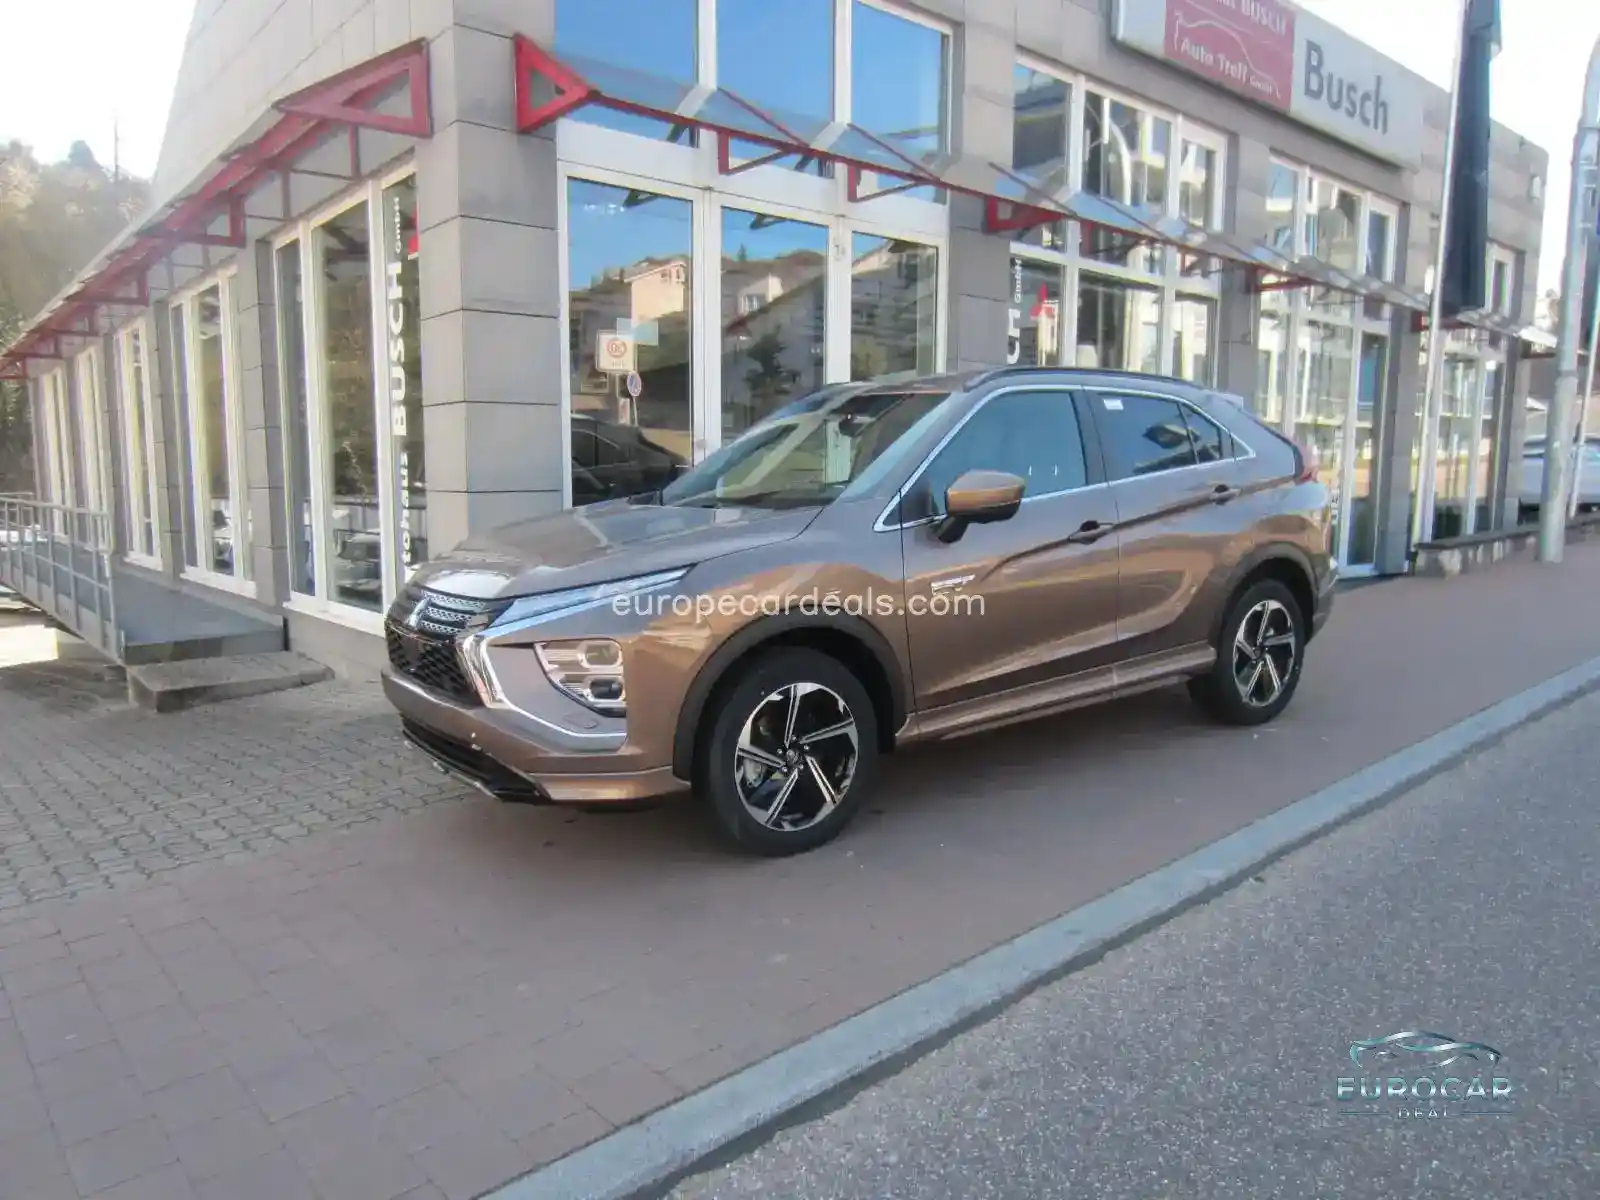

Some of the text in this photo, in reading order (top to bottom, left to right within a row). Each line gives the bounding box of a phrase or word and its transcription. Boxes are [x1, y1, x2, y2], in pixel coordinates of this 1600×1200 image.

[1180, 37, 1214, 66] Auto
[1303, 39, 1390, 136] Busch
[386, 196, 412, 566] tohaus BUSCH GmbH
